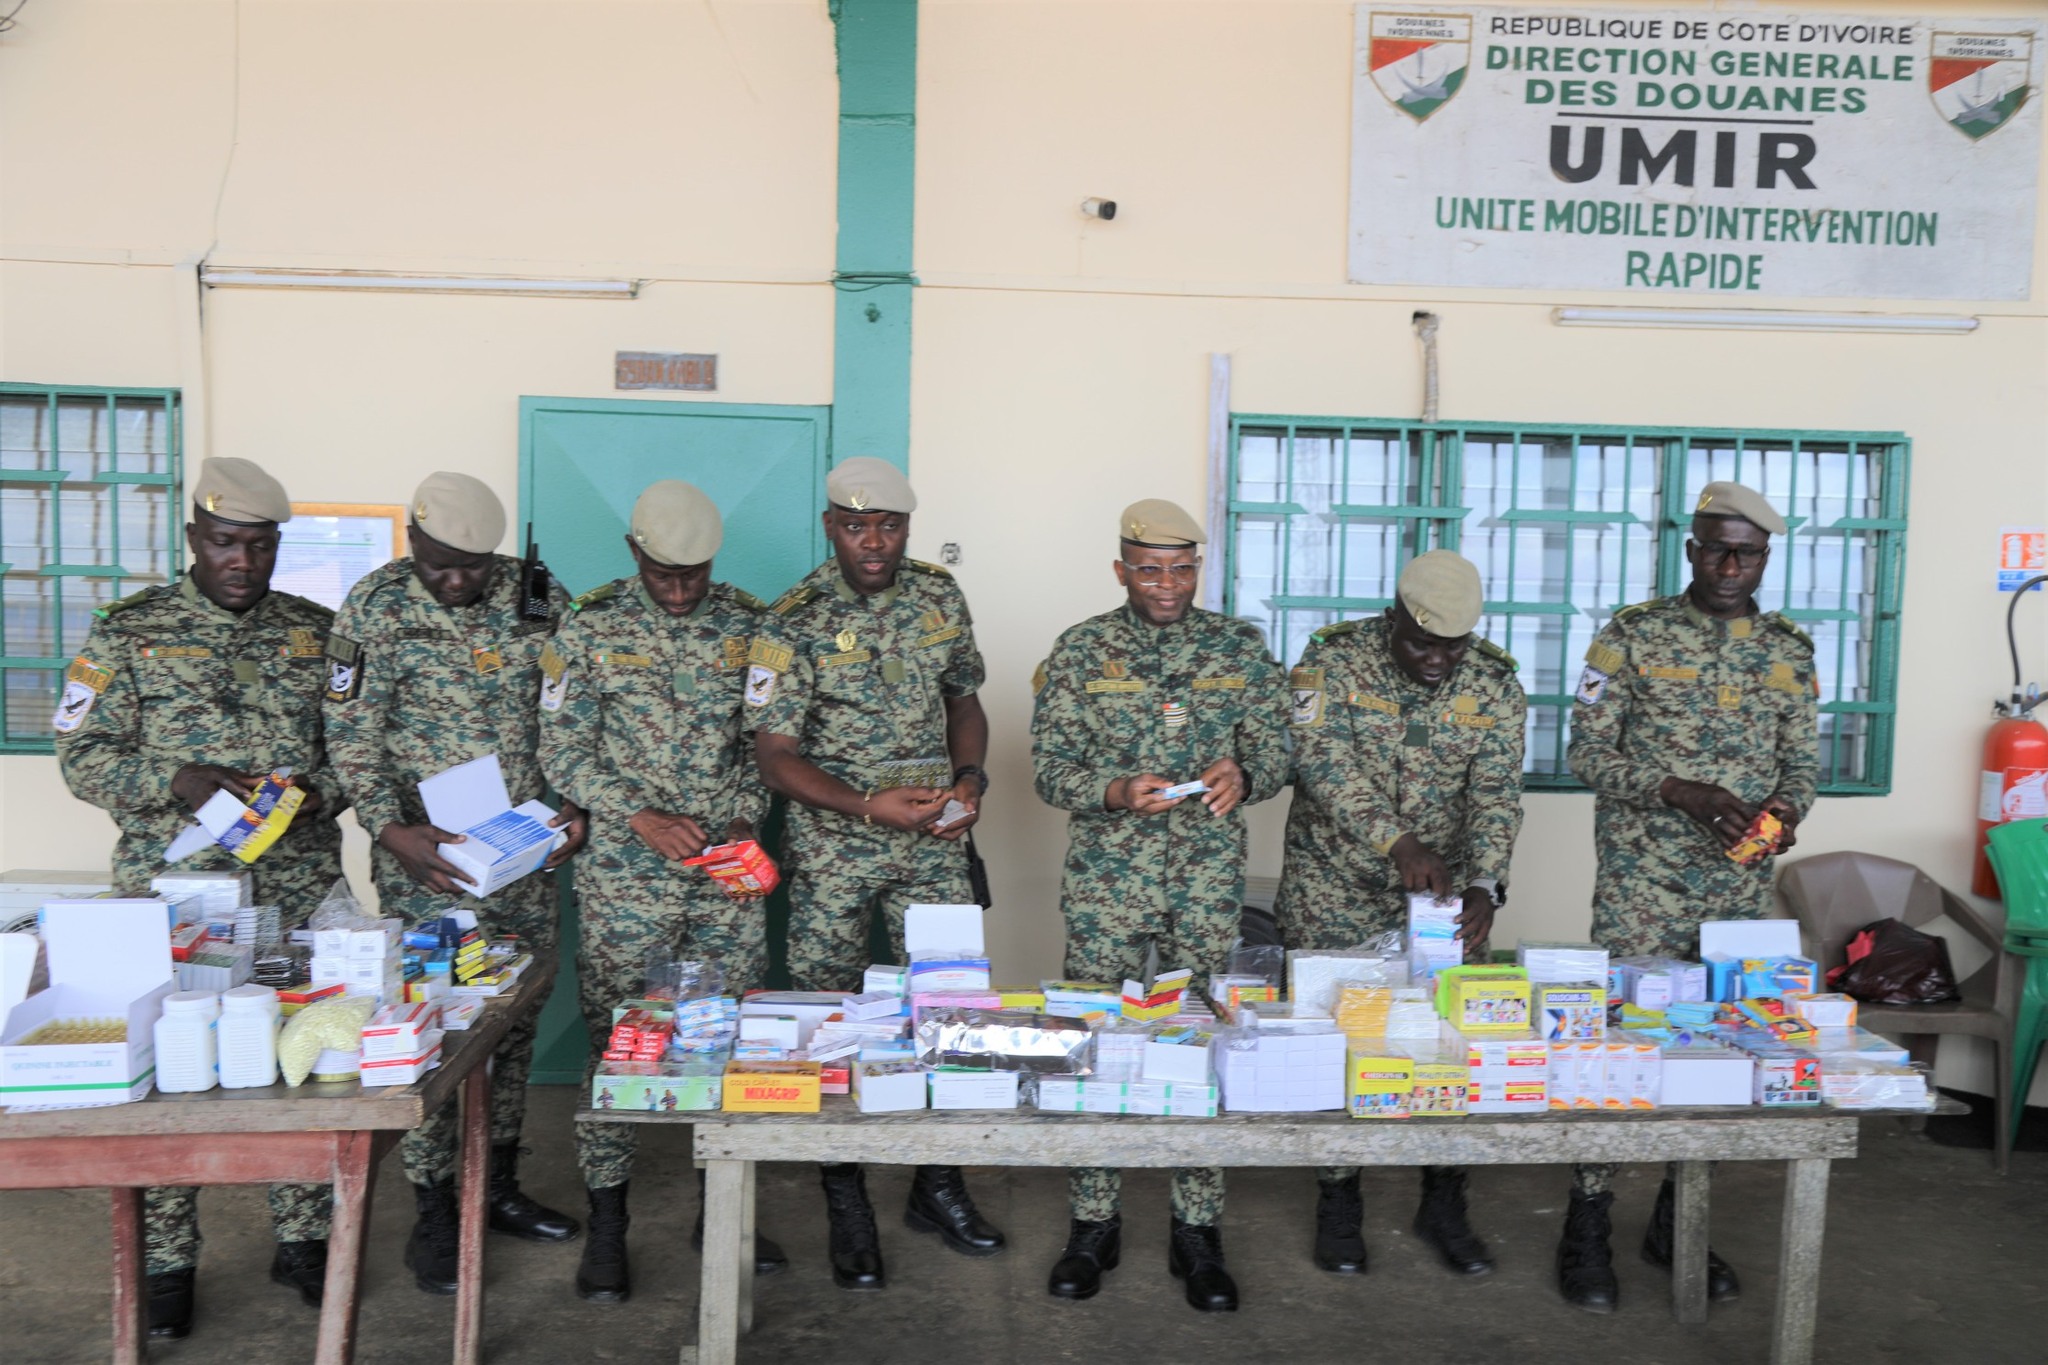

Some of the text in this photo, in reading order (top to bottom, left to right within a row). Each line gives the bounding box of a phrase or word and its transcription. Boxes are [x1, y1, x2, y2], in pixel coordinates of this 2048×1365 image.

[1491, 17, 1914, 44] REPUBLIQUE DE COTE D'IVOIRE
[1486, 45, 1914, 81] DIRECTION GENERALE
[1525, 79, 1868, 114] DES DOUANES
[1549, 125, 1818, 190] UMIR
[1436, 197, 1938, 247] UNITE MOBILE D'INTERVENTION
[1625, 250, 1764, 290] RAPIDE
